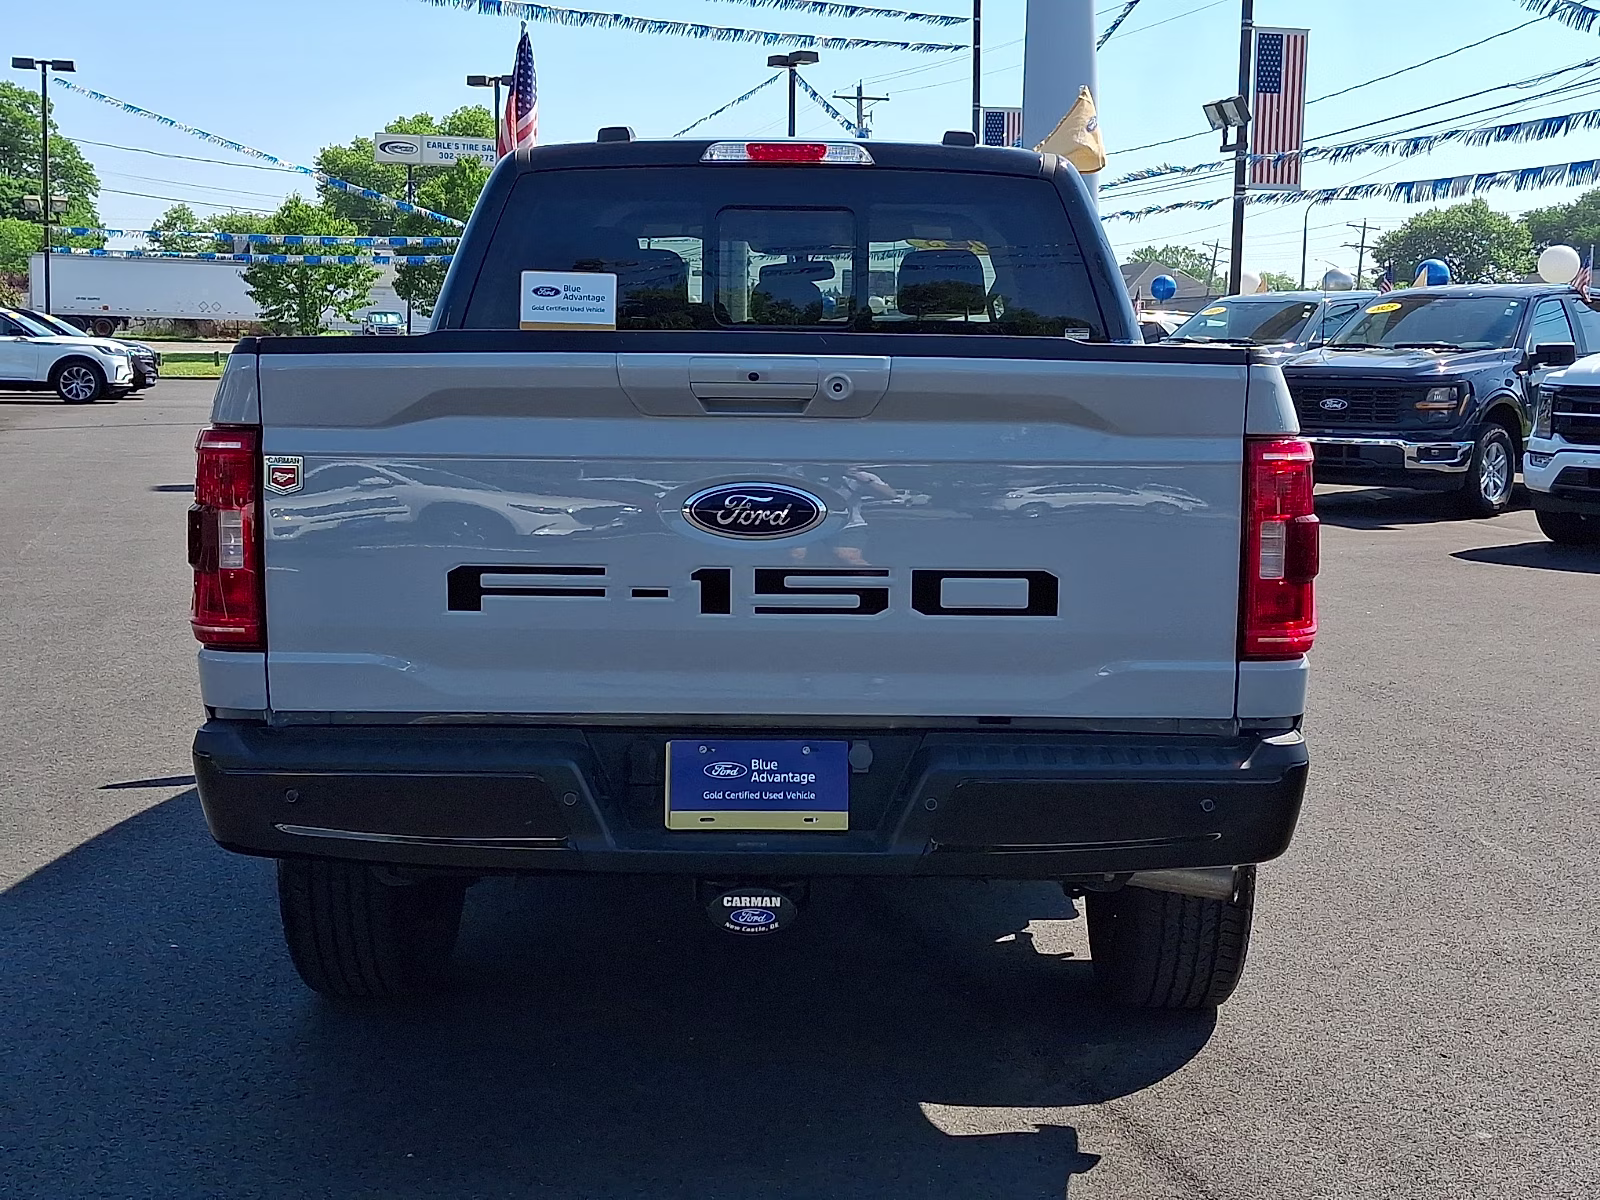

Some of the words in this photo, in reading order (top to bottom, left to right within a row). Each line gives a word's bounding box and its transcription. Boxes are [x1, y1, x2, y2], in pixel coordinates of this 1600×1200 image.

[427, 141, 459, 150] EARLE'S
[462, 143, 479, 151] TIRE
[537, 288, 556, 296] Ford
[563, 284, 582, 293] Blue
[563, 293, 606, 303] Advantage
[267, 456, 300, 464] CARMAN
[716, 494, 793, 525] Ford
[446, 564, 1059, 617] F-150
[751, 758, 778, 770] Blue
[711, 764, 739, 776] Ford
[750, 771, 816, 785] Advantage
[703, 790, 723, 800] Gold
[725, 790, 760, 800] Certified
[762, 791, 784, 800] Used
[786, 791, 816, 800] Vehicle
[723, 896, 781, 907] CARMAN
[739, 910, 767, 922] Ford
[724, 922, 741, 930] New
[770, 922, 780, 930] DE
